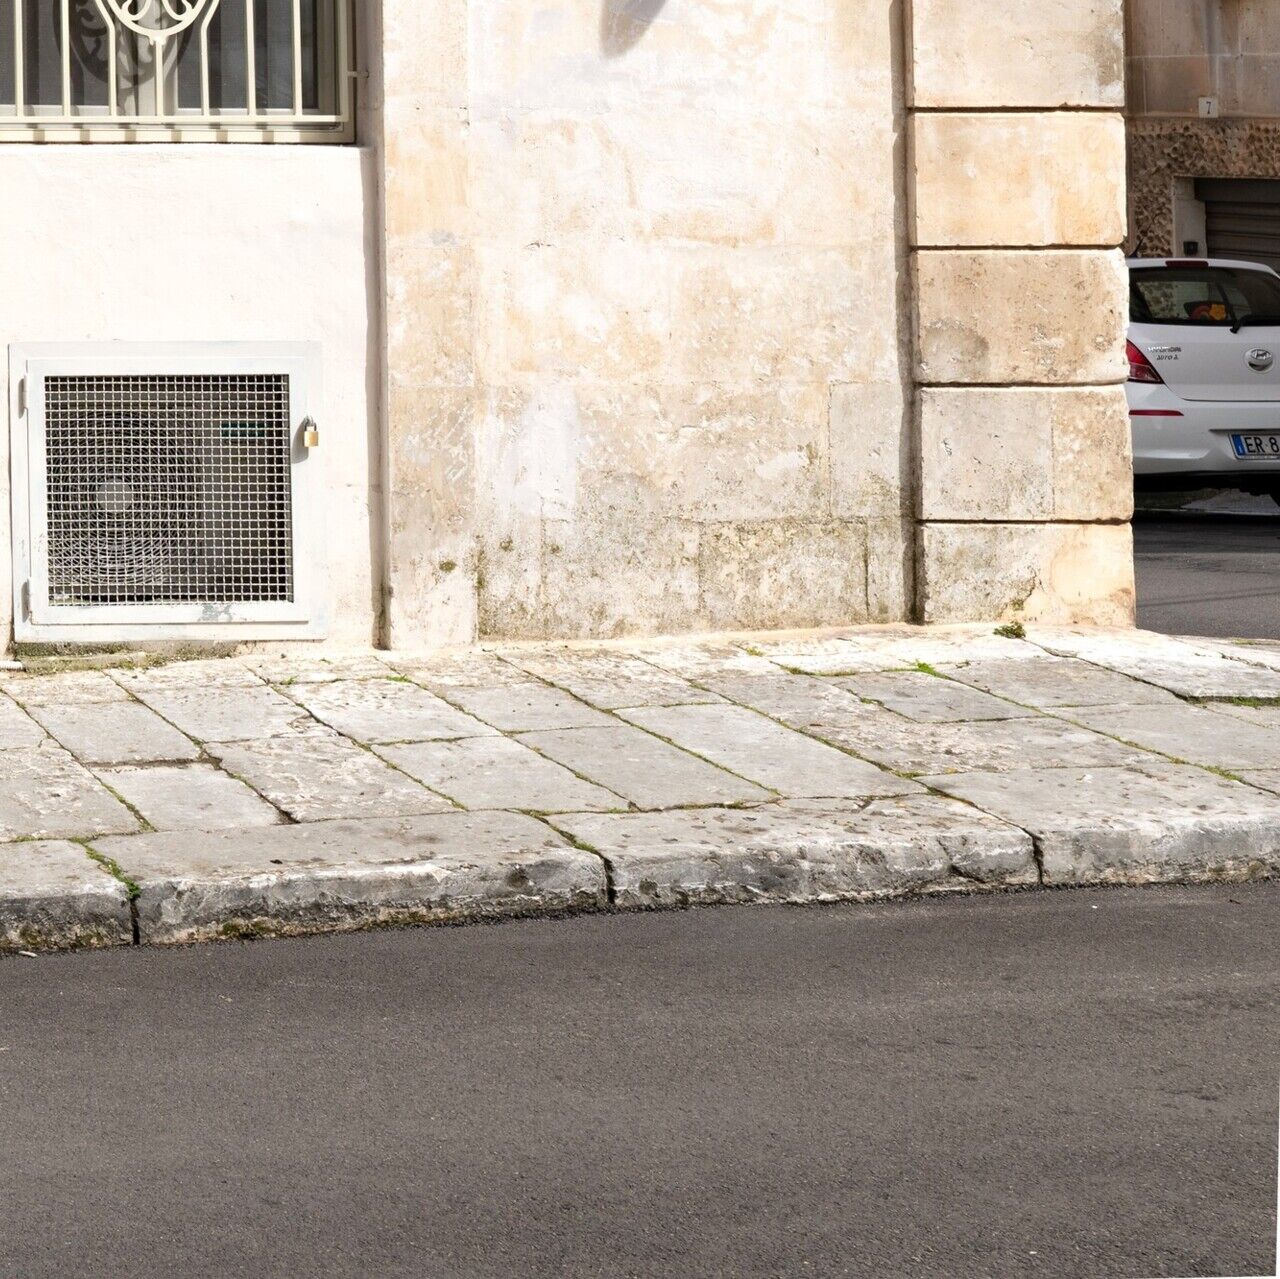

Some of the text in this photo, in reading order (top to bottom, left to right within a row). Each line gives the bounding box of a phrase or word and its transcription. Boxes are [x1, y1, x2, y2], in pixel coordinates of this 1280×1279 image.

[1205, 100, 1212, 115] 7
[1244, 437, 1280, 453] ER 8
